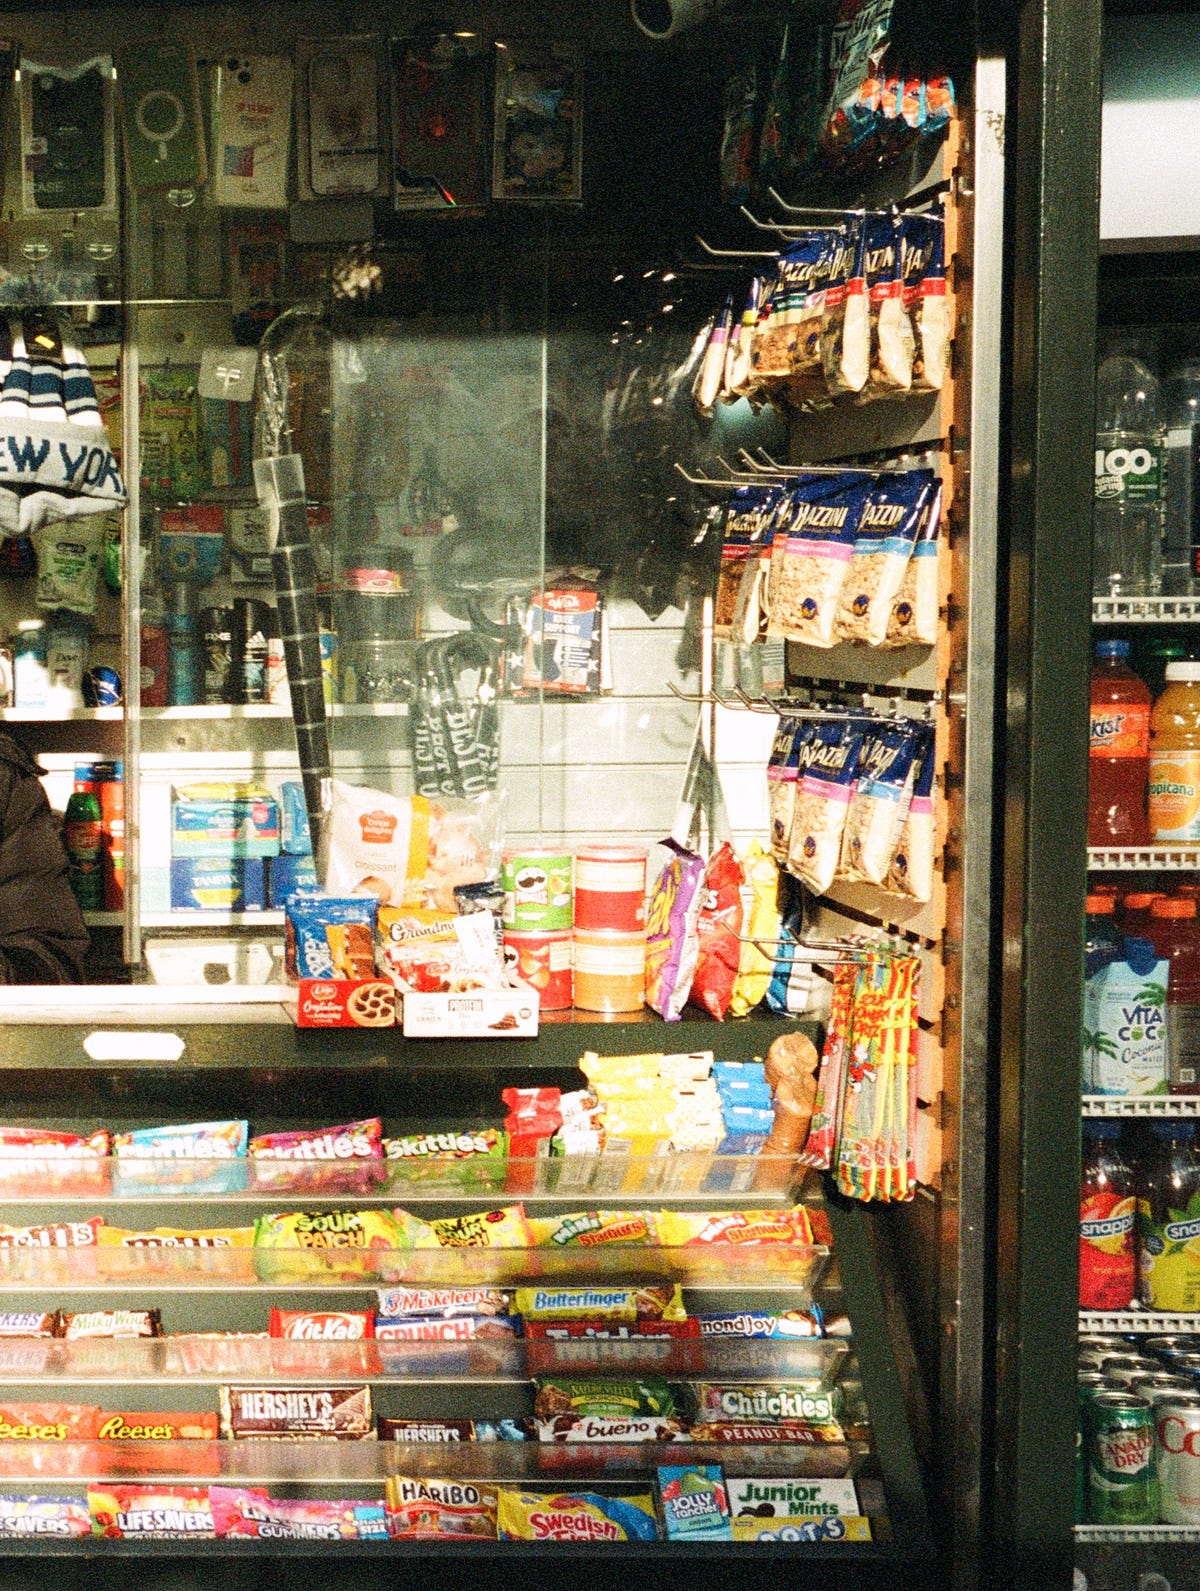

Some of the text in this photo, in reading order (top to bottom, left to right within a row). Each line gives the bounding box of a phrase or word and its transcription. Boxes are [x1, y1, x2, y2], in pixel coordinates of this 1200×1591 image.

[1090, 713, 1125, 738] kist
[1122, 1004, 1163, 1025] VITA
[387, 1132, 489, 1158] Skittles
[296, 1211, 359, 1231] SOUR
[296, 1229, 365, 1249] PATCH
[578, 1219, 648, 1247] Starburst
[386, 1289, 486, 1313] 3 Musketeers
[534, 1290, 630, 1311] Butterfinger
[745, 1316, 776, 1336] Joy
[241, 1392, 336, 1420] HERSHEY'S
[98, 1415, 176, 1440] Reese's
[586, 1420, 650, 1440] bueno
[724, 1426, 815, 1442] PEANUT BAR
[1113, 1451, 1148, 1471] DRY
[401, 1483, 479, 1506] HARIBO
[670, 1492, 712, 1513] JOLLY
[737, 1483, 822, 1502] Junior
[787, 1501, 840, 1517] Mints
[529, 1512, 619, 1540] Swedish
